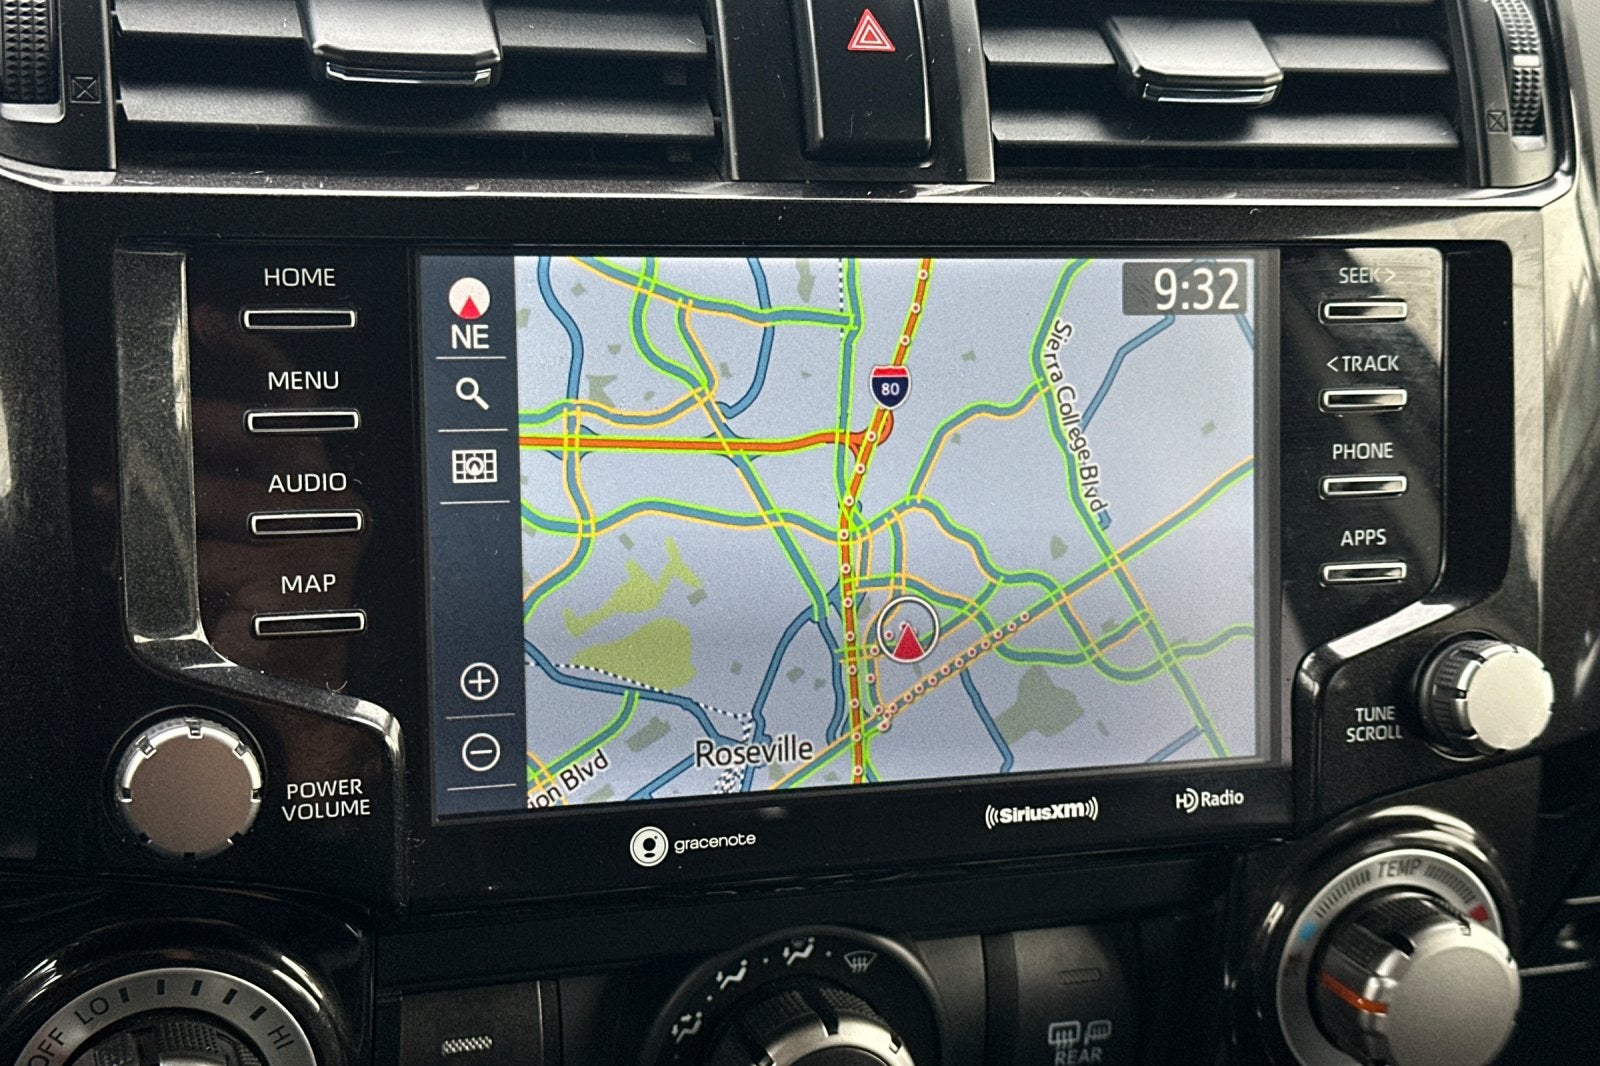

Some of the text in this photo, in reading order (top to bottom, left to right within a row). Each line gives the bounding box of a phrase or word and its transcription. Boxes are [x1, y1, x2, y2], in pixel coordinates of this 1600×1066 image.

[264, 267, 336, 287] HOME
[1339, 267, 1381, 284] SEEK
[1154, 267, 1239, 311] 9:32
[451, 323, 490, 350] NE
[1341, 355, 1400, 372] TRACK
[268, 371, 339, 391] MENU
[881, 382, 900, 396] 80
[1044, 319, 1109, 513] Sierra College Blvd
[1332, 442, 1394, 460] PHONE
[268, 472, 347, 493] AUDIO
[1340, 528, 1387, 547] APPS
[281, 573, 336, 594] MAP
[1354, 705, 1396, 723] TUNE
[1345, 724, 1404, 743] SCROLL
[695, 734, 813, 768] Roseville
[560, 748, 608, 791] Blvd
[287, 778, 363, 800] POWER
[1201, 788, 1245, 808] Radio
[281, 799, 371, 822] VOLUME
[674, 833, 757, 854] gracenote
[1378, 858, 1422, 878] TEMP
[74, 996, 110, 1025] LO
[27, 1026, 65, 1066] OFF
[267, 1024, 294, 1051] HI
[1055, 1046, 1103, 1066] REAR
